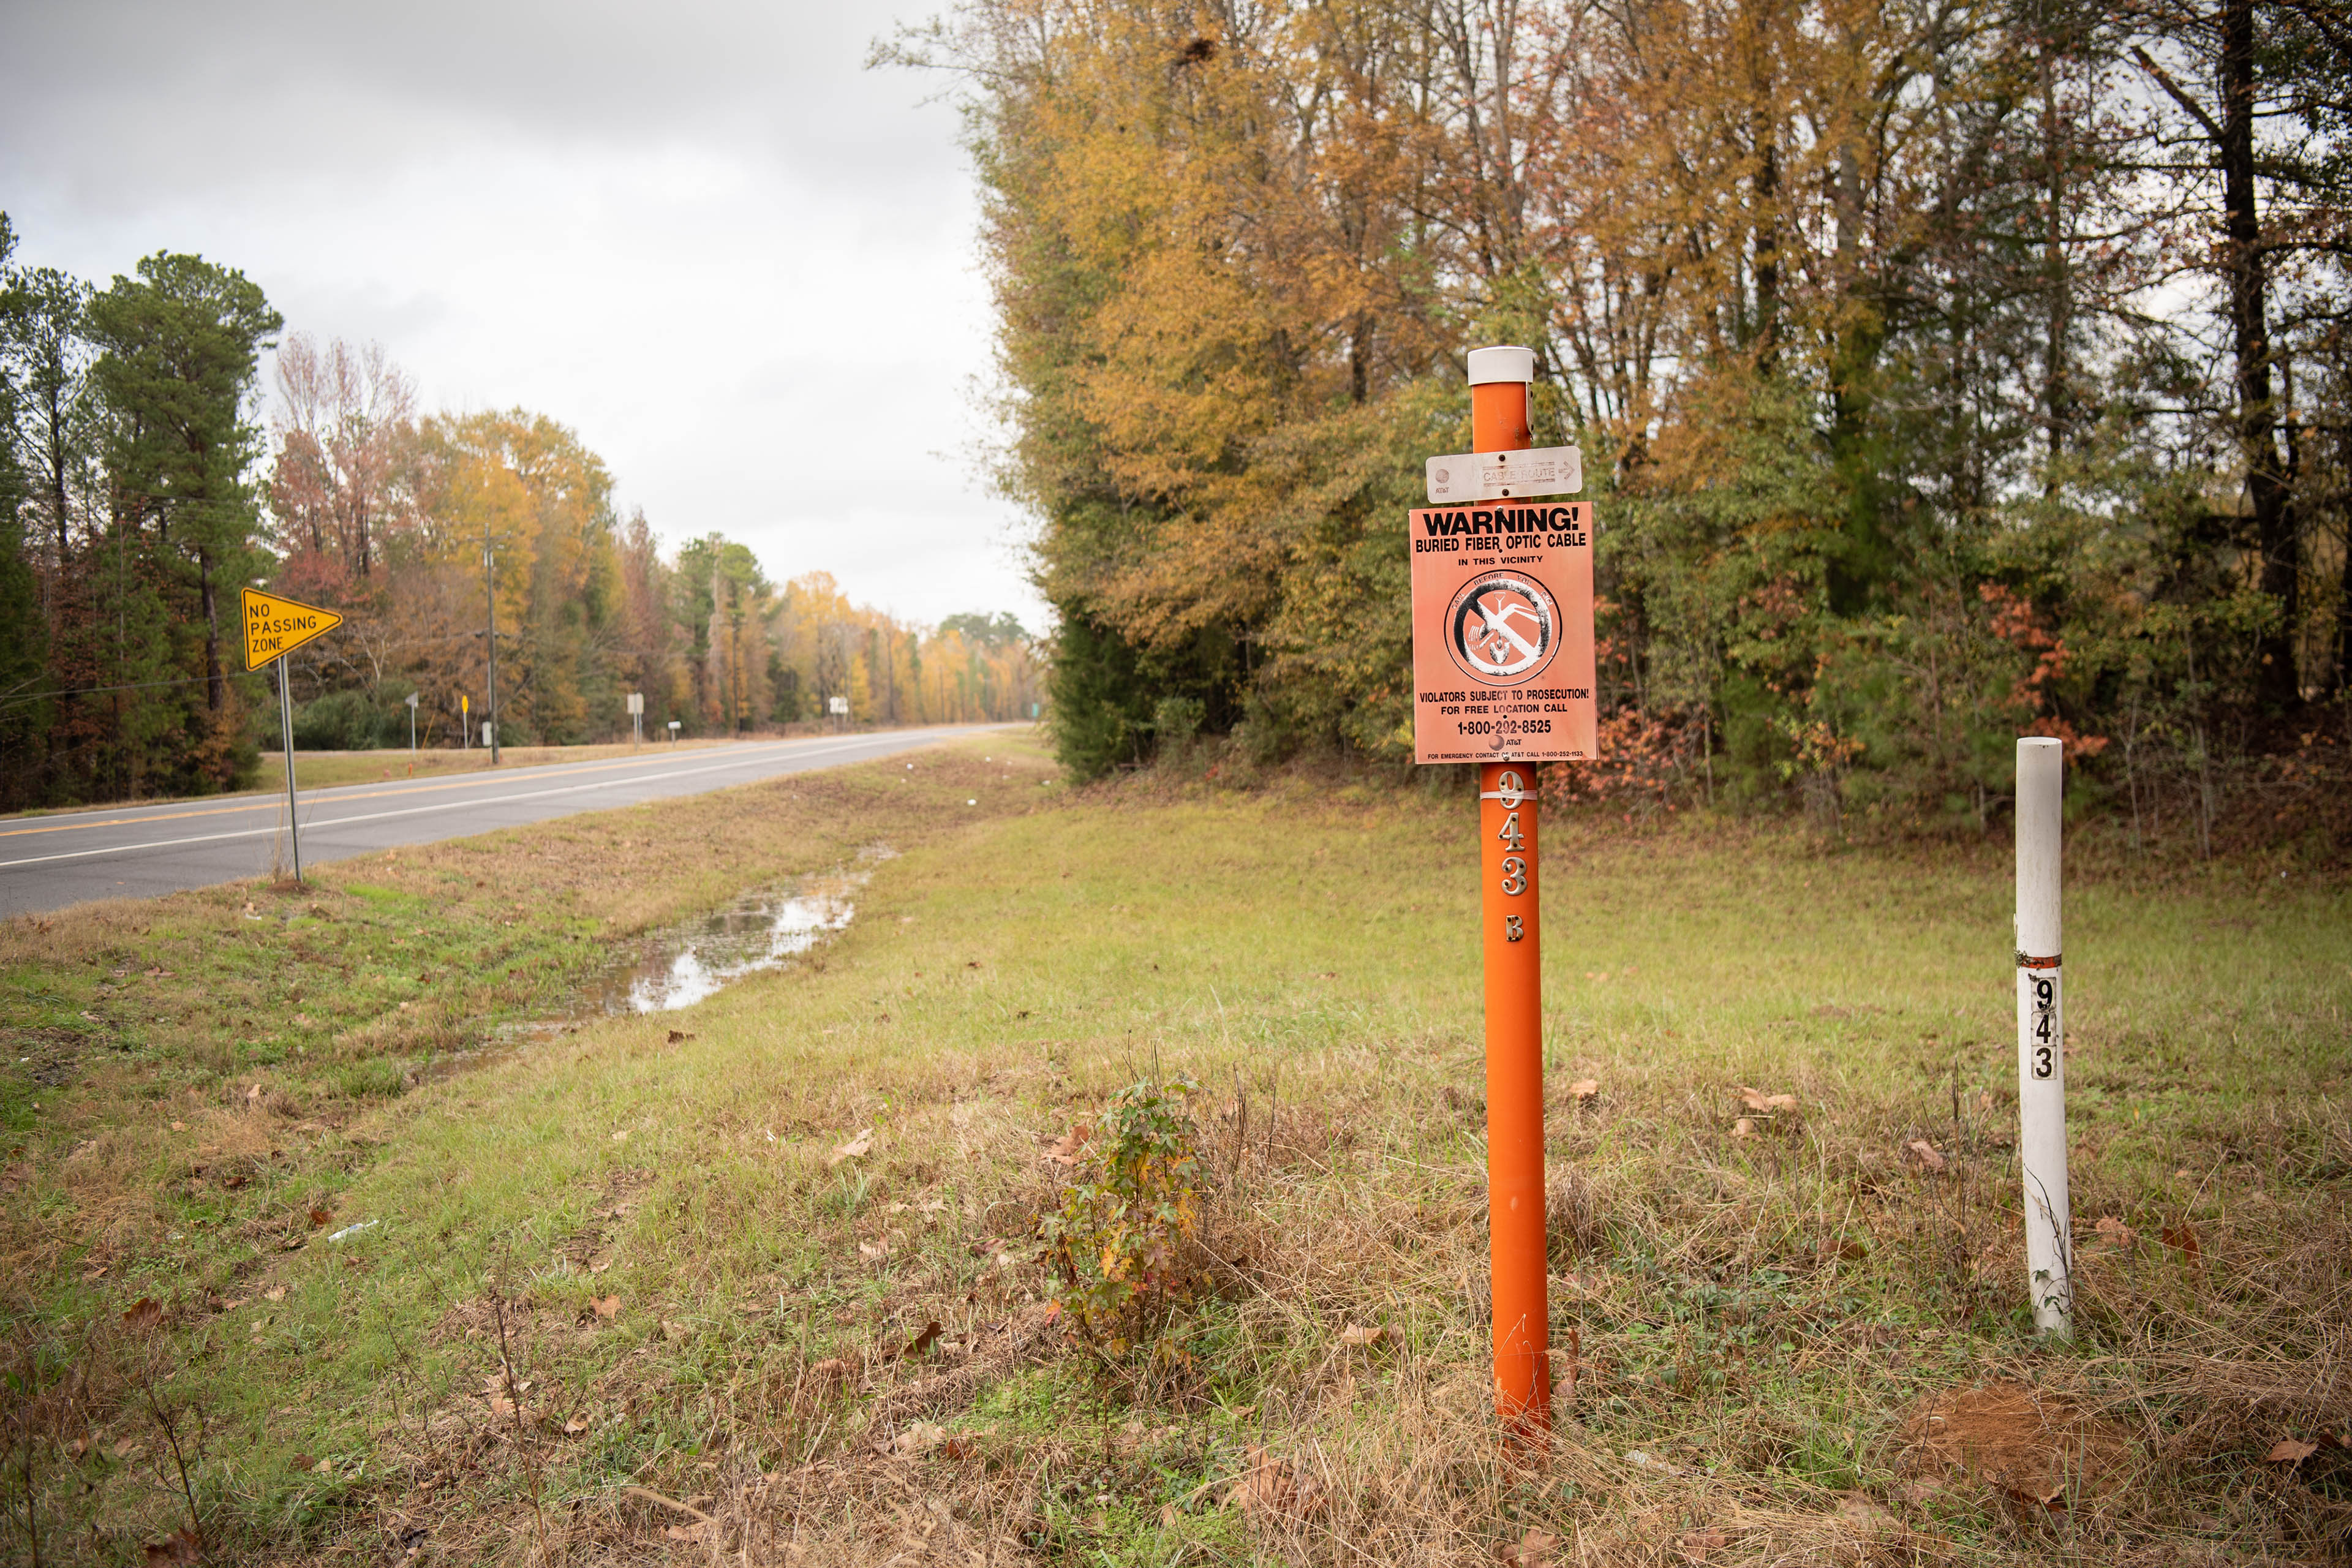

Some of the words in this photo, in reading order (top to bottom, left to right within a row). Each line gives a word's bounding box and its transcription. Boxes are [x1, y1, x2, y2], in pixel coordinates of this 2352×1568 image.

[1483, 470, 1516, 481] CABE
[1521, 467, 1555, 478] ROUTE
[1422, 507, 1578, 537] WARNING!
[1415, 537, 1459, 552] BURIED
[1465, 536, 1500, 551] FIBER
[1506, 534, 1541, 549] OPTIC
[1547, 532, 1586, 548] CABLE
[1501, 556, 1544, 564] VICINITY
[1452, 592, 1465, 609] CALL
[1473, 572, 1505, 586] BEFORE
[1517, 575, 1532, 586] YOU
[249, 603, 270, 618] NO
[251, 616, 317, 635] PASSING
[252, 636, 284, 653] ZONE
[1420, 691, 1466, 703] VIOLATORS
[1470, 690, 1508, 702] SUBJECT
[1512, 690, 1523, 701] TO
[1526, 688, 1589, 700] PROSECUTION!
[1441, 706, 1460, 715] FOR
[1464, 705, 1489, 714] FREE
[1494, 704, 1540, 714] LOCATION
[1544, 703, 1568, 712] CALL
[1457, 719, 1551, 735] 1-800-292-8525
[1498, 771, 1527, 895] 943
[1506, 915, 1525, 941] B
[2036, 979, 2052, 1078] 943
